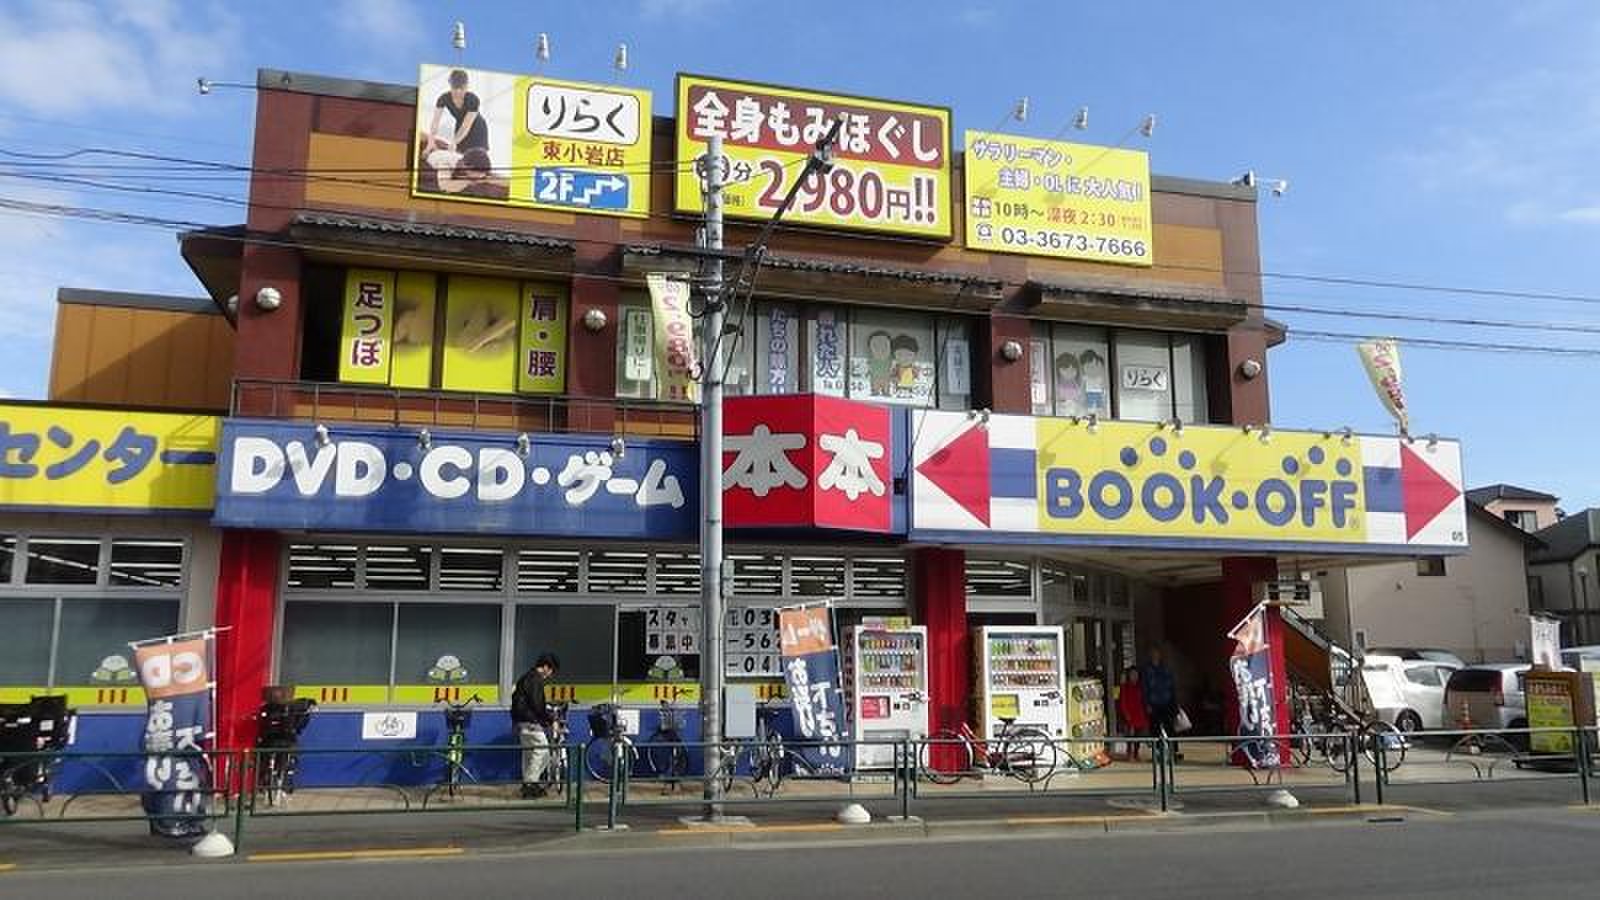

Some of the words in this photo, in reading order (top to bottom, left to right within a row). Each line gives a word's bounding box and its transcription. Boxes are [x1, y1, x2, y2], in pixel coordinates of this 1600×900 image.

[542, 95, 625, 138] りらく
[692, 91, 939, 162] 全身もみほぐし
[542, 141, 625, 167] 東小岩店
[538, 172, 574, 202] 2F
[1001, 227, 1146, 257] 03-3673-7666
[351, 281, 384, 367] 足つぼ
[526, 293, 560, 378] 肩・腰
[1127, 370, 1162, 387] りらく
[0, 421, 217, 484] センター
[722, 424, 807, 497] 本
[818, 429, 886, 501] 本
